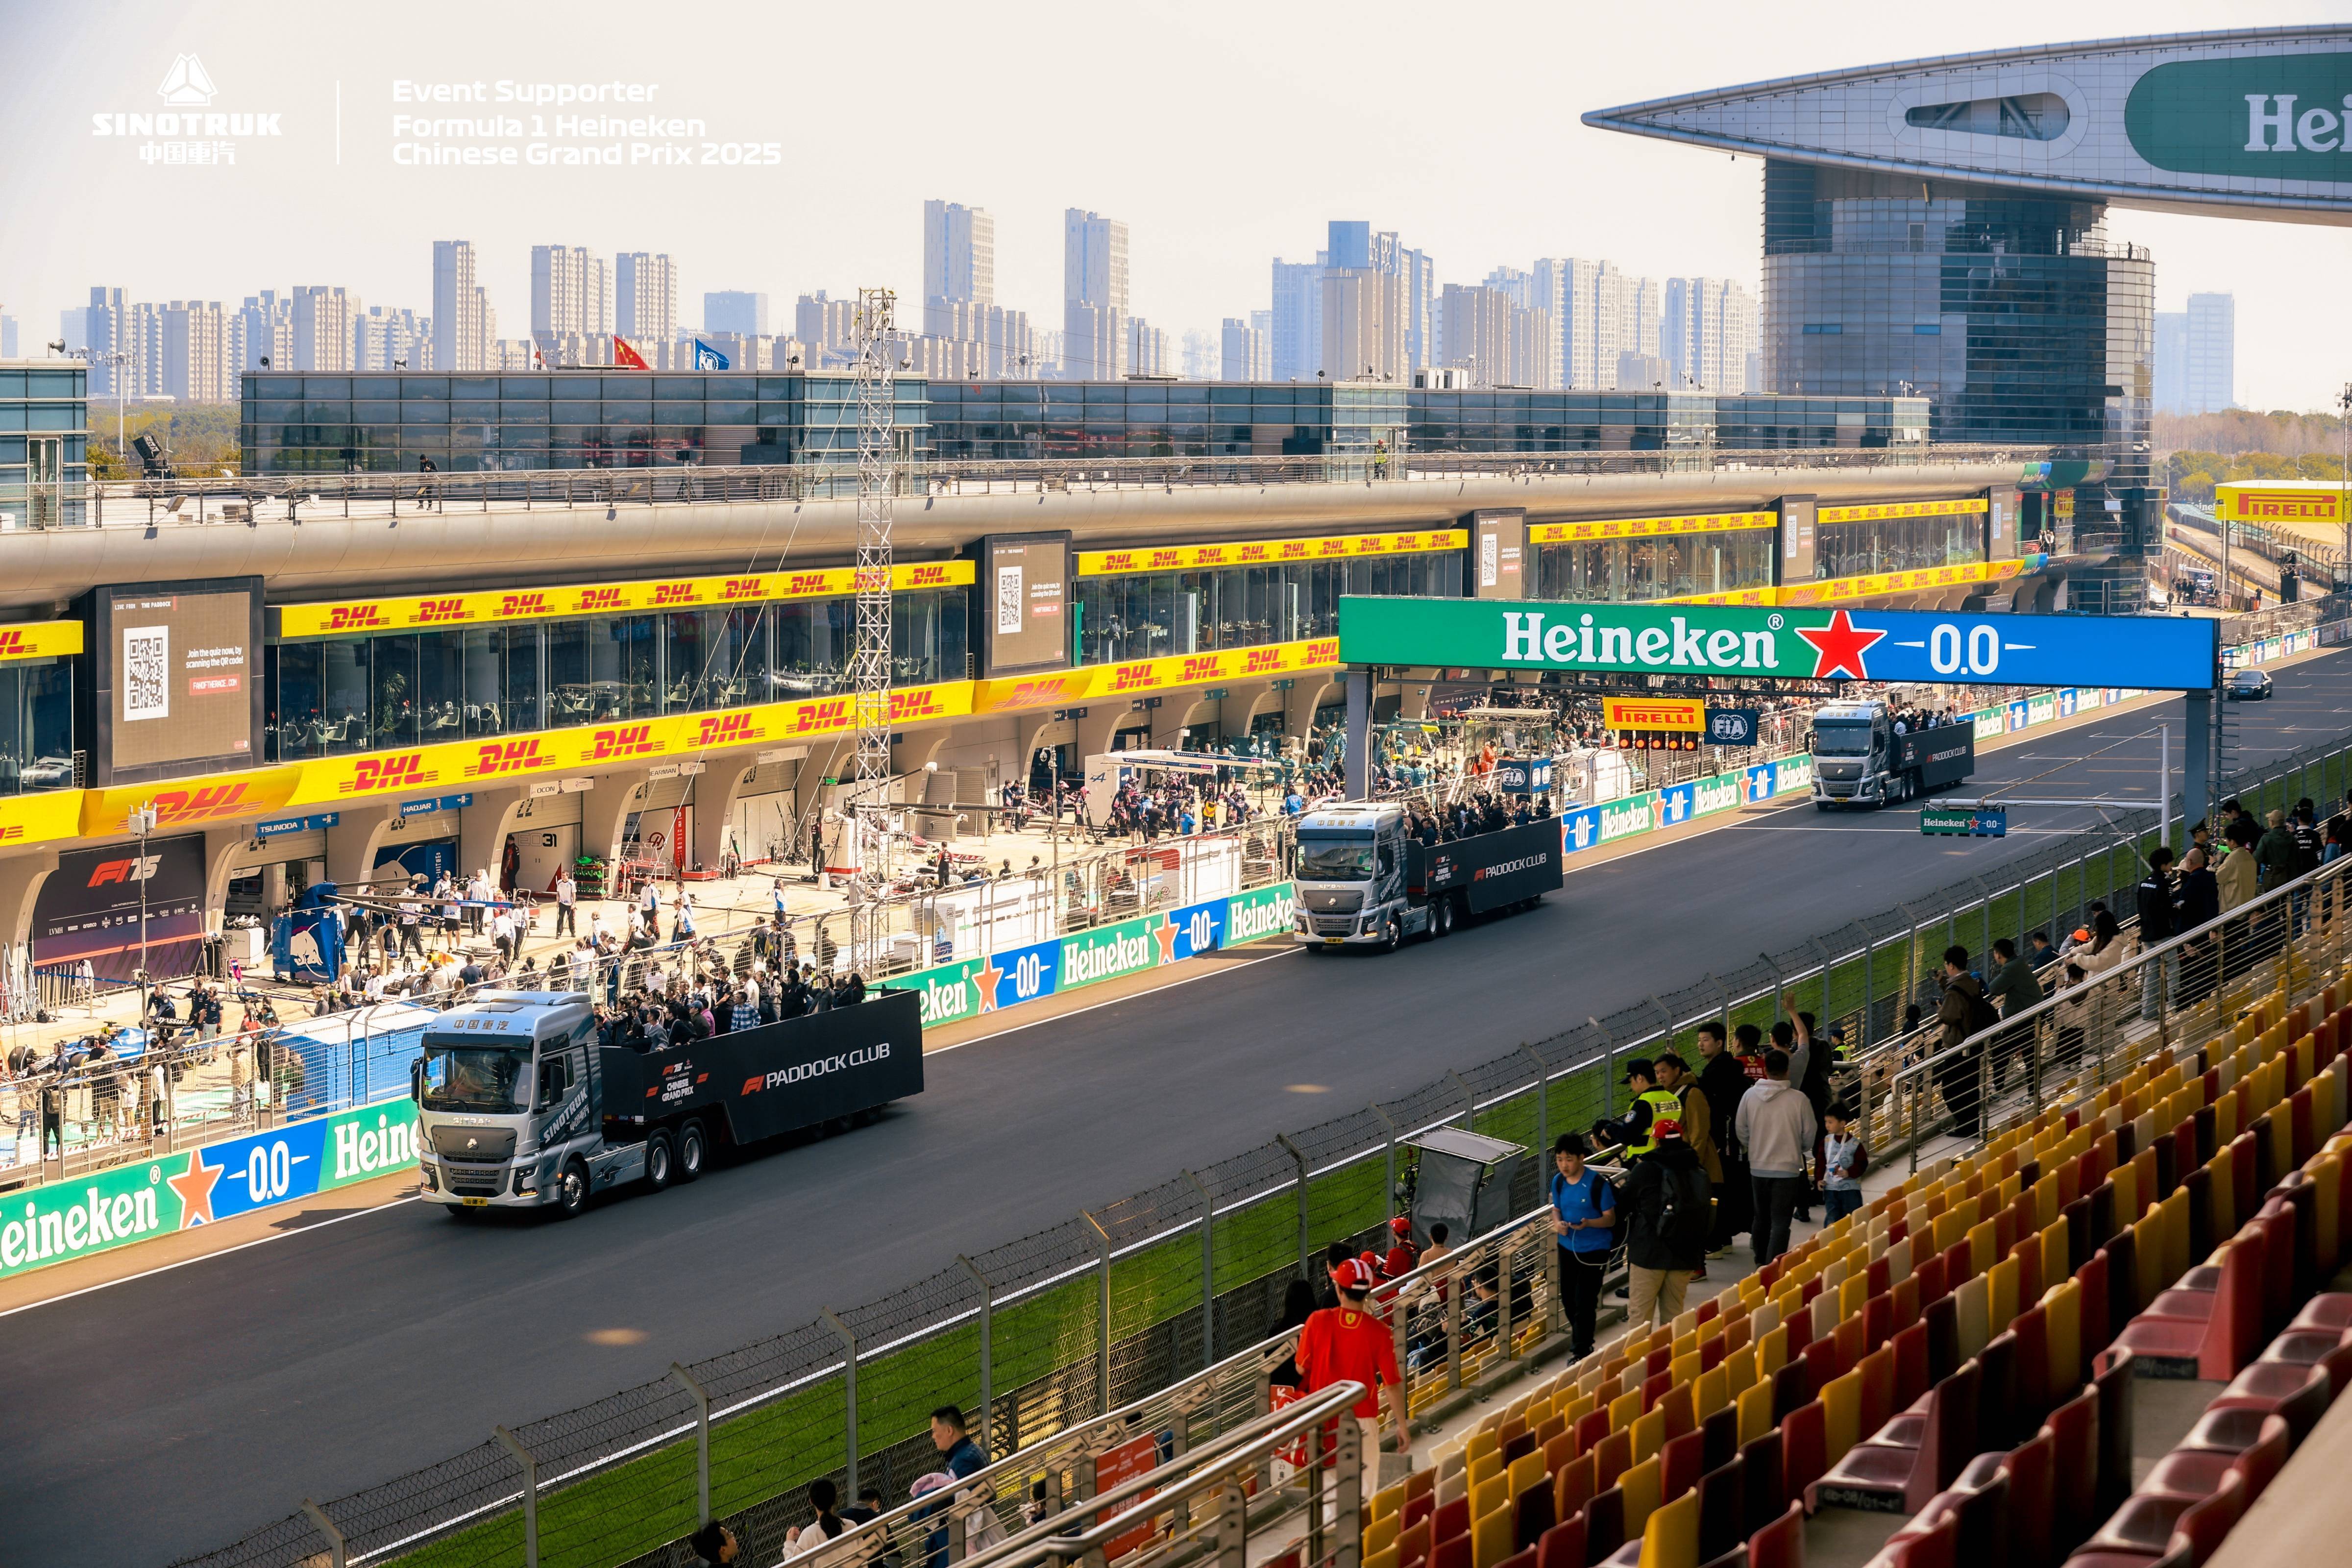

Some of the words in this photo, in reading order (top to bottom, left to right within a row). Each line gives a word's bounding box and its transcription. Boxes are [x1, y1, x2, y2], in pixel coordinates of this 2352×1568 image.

[2238, 493, 2337, 517] PIRELLI
[1547, 528, 1562, 538] DHL
[1576, 526, 1591, 536] DHL
[1604, 524, 1618, 535] DHL
[1632, 523, 1645, 533] DHL
[1658, 521, 1671, 531] DHL
[1684, 519, 1695, 529] DHL
[1707, 518, 1719, 528] DHL
[1106, 555, 1132, 569] DHL
[1153, 552, 1178, 566] DHL
[1199, 549, 1222, 564] DHL
[1242, 547, 1264, 560] DHL
[1284, 544, 1305, 557] DHL
[1323, 541, 1343, 554] DHL
[1361, 539, 1380, 552] DHL
[1397, 537, 1416, 549] DHL
[1432, 535, 1450, 546] DHL
[331, 606, 379, 628] DHL
[419, 600, 464, 621] DHL
[503, 594, 545, 615] DHL
[581, 589, 621, 609] DHL
[656, 584, 694, 603] DHL
[726, 580, 761, 598] DHL
[792, 575, 825, 593] DHL
[855, 571, 885, 588] DHL
[913, 567, 944, 584] DHL
[187, 649, 199, 658] Join
[210, 648, 221, 658] quiz
[1502, 612, 1780, 668] Heineken
[1931, 624, 1999, 675] 0.0
[186, 658, 210, 668] scanning
[220, 658, 228, 666] QR
[229, 656, 244, 665] code!
[1116, 665, 1153, 689] DHL
[1184, 658, 1219, 681] DHL
[1248, 650, 1281, 672] DHL
[1307, 643, 1338, 663] DHL
[1006, 679, 1064, 707] DHL
[1614, 705, 1694, 724] PIRELLI
[355, 755, 423, 791] DHL
[478, 740, 542, 774] DHL
[594, 727, 652, 759] DHL
[700, 714, 754, 745] DHL
[798, 702, 847, 731] DHL
[889, 692, 934, 718] DHL
[1932, 749, 1955, 762] PADDOCK
[1955, 746, 1966, 755] CLUB
[152, 784, 248, 823] DHL
[403, 803, 431, 812] HADJAR
[1694, 782, 1738, 815] Heineken
[260, 822, 297, 833] TSUNODA
[1575, 813, 1589, 848] 0.0
[1601, 802, 1649, 840] Heineken
[1923, 818, 1965, 828] Heineken
[1486, 858, 1525, 878] PADDOCK
[1526, 853, 1546, 867] CLUB
[49, 927, 63, 935] LVMH
[1190, 909, 1210, 952] 0.0
[1016, 952, 1040, 999] 0.0
[1063, 930, 1150, 986] Heineken
[453, 1019, 510, 1030] 中国重汽
[766, 1054, 847, 1090] PADDOCK
[849, 1043, 890, 1066] CLUB
[662, 1090, 681, 1102] GRAND
[681, 1086, 694, 1097] PRIX
[667, 1078, 689, 1091] CHINESE
[543, 1087, 588, 1144] SINOTRUK
[568, 1104, 590, 1131] 中国重汽
[0, 1187, 159, 1269] eineken
[248, 1140, 289, 1203] 0.0
